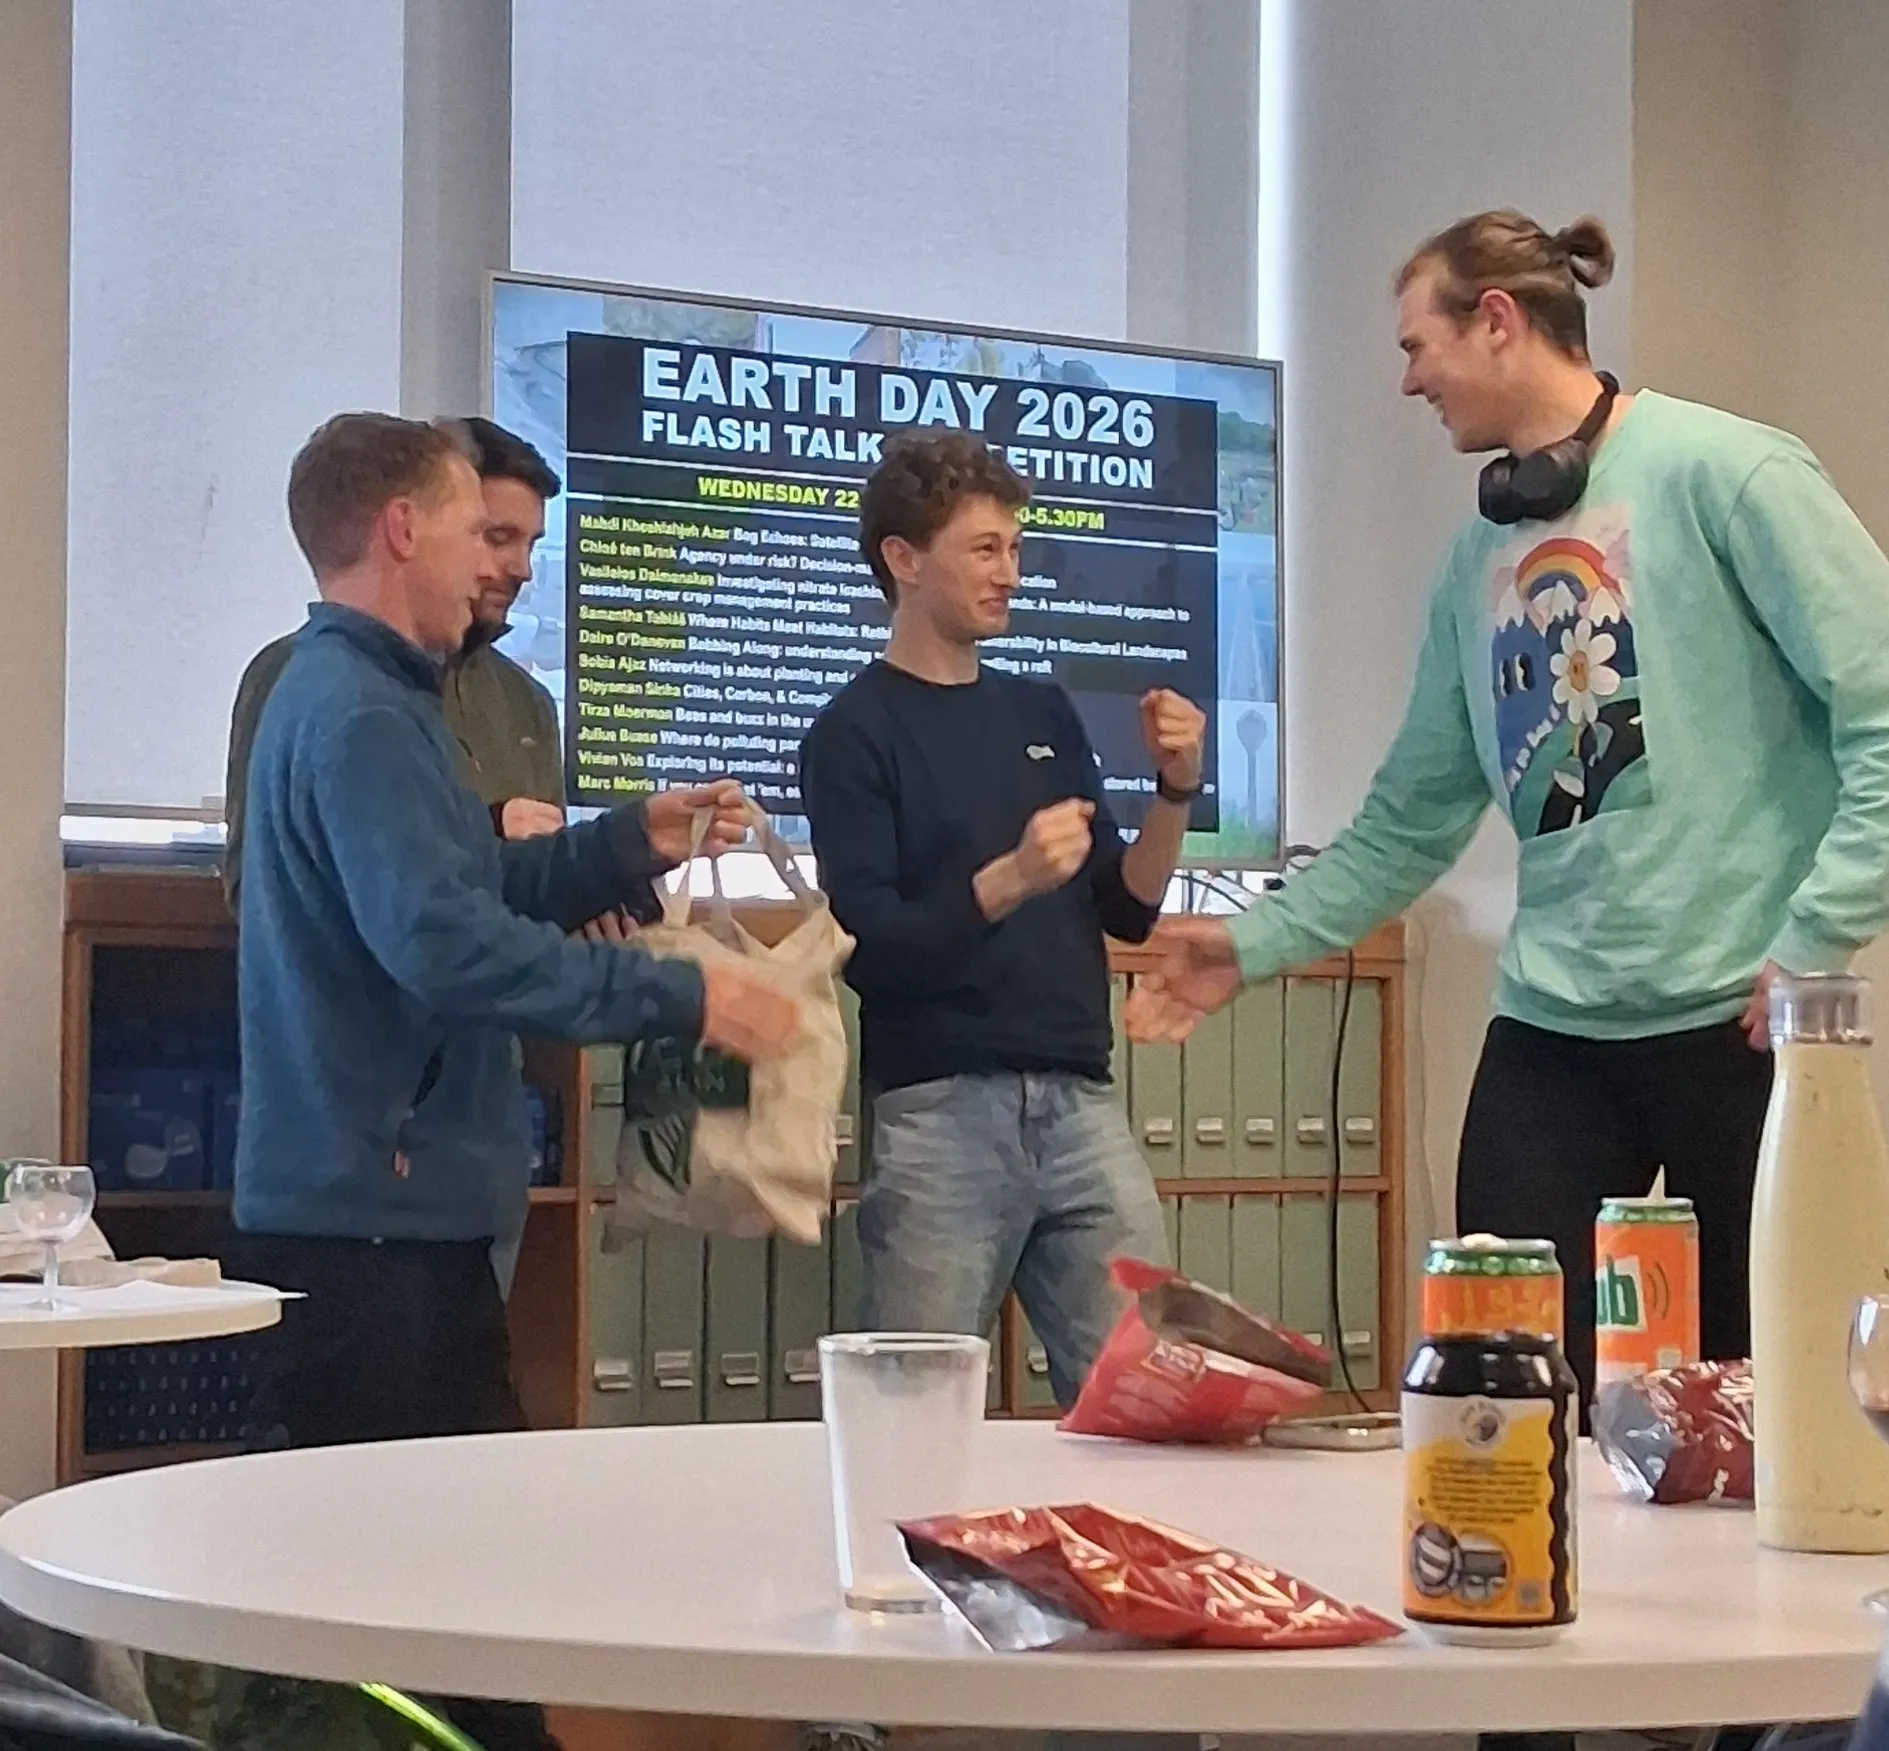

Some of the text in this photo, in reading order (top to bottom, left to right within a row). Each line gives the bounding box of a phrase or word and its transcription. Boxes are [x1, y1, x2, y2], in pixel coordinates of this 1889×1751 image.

[643, 348, 1154, 447] EARTH DAY 2026
[642, 410, 1153, 489] FLASH TALK ETITION
[698, 476, 1105, 530] WEDNESDAY 22 0-5.30PM
[680, 546, 727, 567] Agency
[729, 553, 766, 567] under
[645, 588, 681, 601] cover
[682, 590, 712, 607] crop
[794, 598, 851, 615] practices
[785, 644, 873, 665] understanding
[649, 658, 721, 678] Networking
[736, 664, 773, 679] about
[825, 670, 848, 684] and
[578, 701, 610, 717] Tirza
[709, 710, 733, 724] and
[781, 713, 800, 728] the
[660, 730, 701, 746] Where
[704, 733, 720, 747] do
[647, 753, 707, 773] Exploring
[578, 775, 611, 790] Marc
[613, 776, 655, 792] Morris
